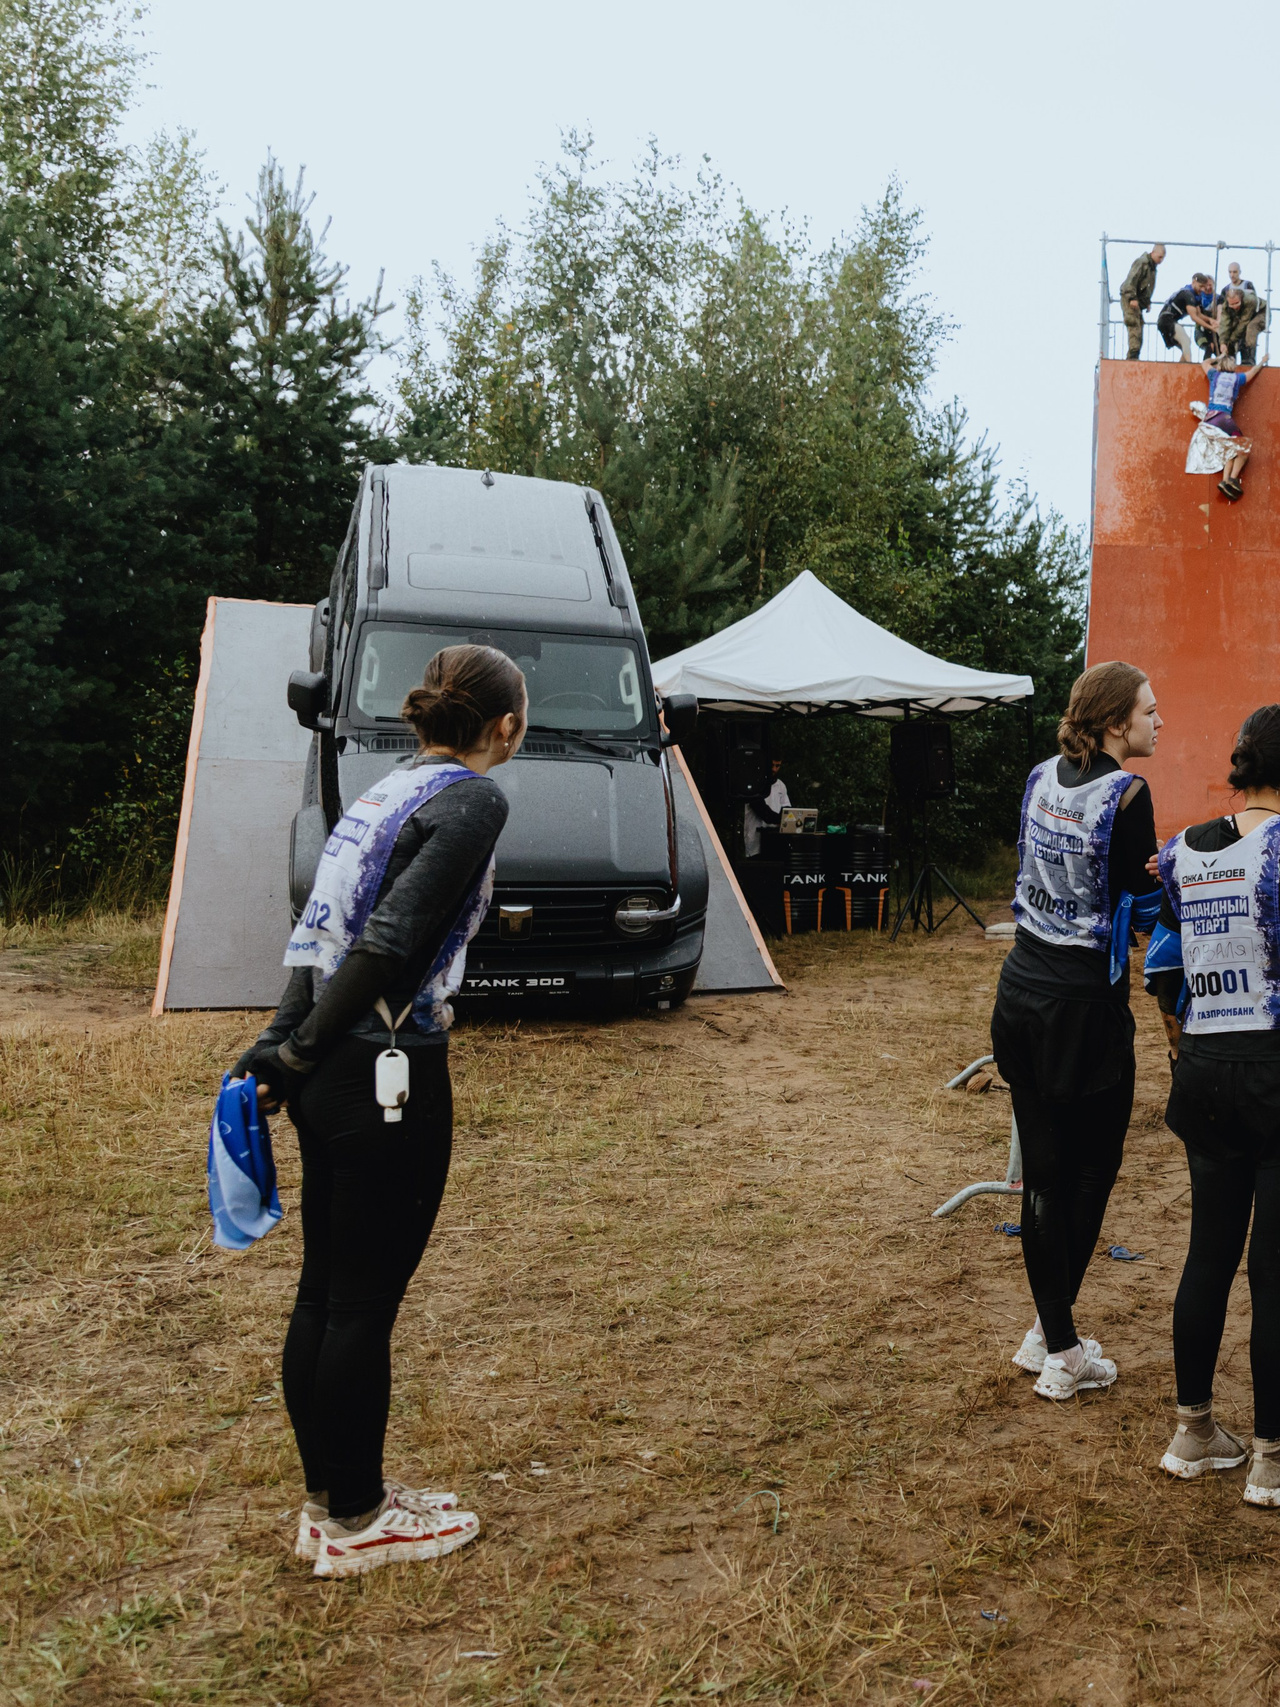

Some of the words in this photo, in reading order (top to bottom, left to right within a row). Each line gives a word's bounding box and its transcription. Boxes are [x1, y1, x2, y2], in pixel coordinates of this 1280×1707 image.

[1037, 796, 1055, 813] ГОНА
[1055, 806, 1085, 821] ГЕРОЕВ
[1035, 844, 1063, 864] СТАРТ
[784, 873, 825, 884] TANK
[840, 872, 888, 883] TANK
[1182, 873, 1204, 885] ОНКА
[1206, 868, 1246, 881] ГЕРОЕВ
[1194, 916, 1227, 935] СТАРТ
[466, 979, 520, 987] TANK
[526, 978, 565, 987] 300
[1197, 1007, 1255, 1020] ГАЗПРОМБАНК
